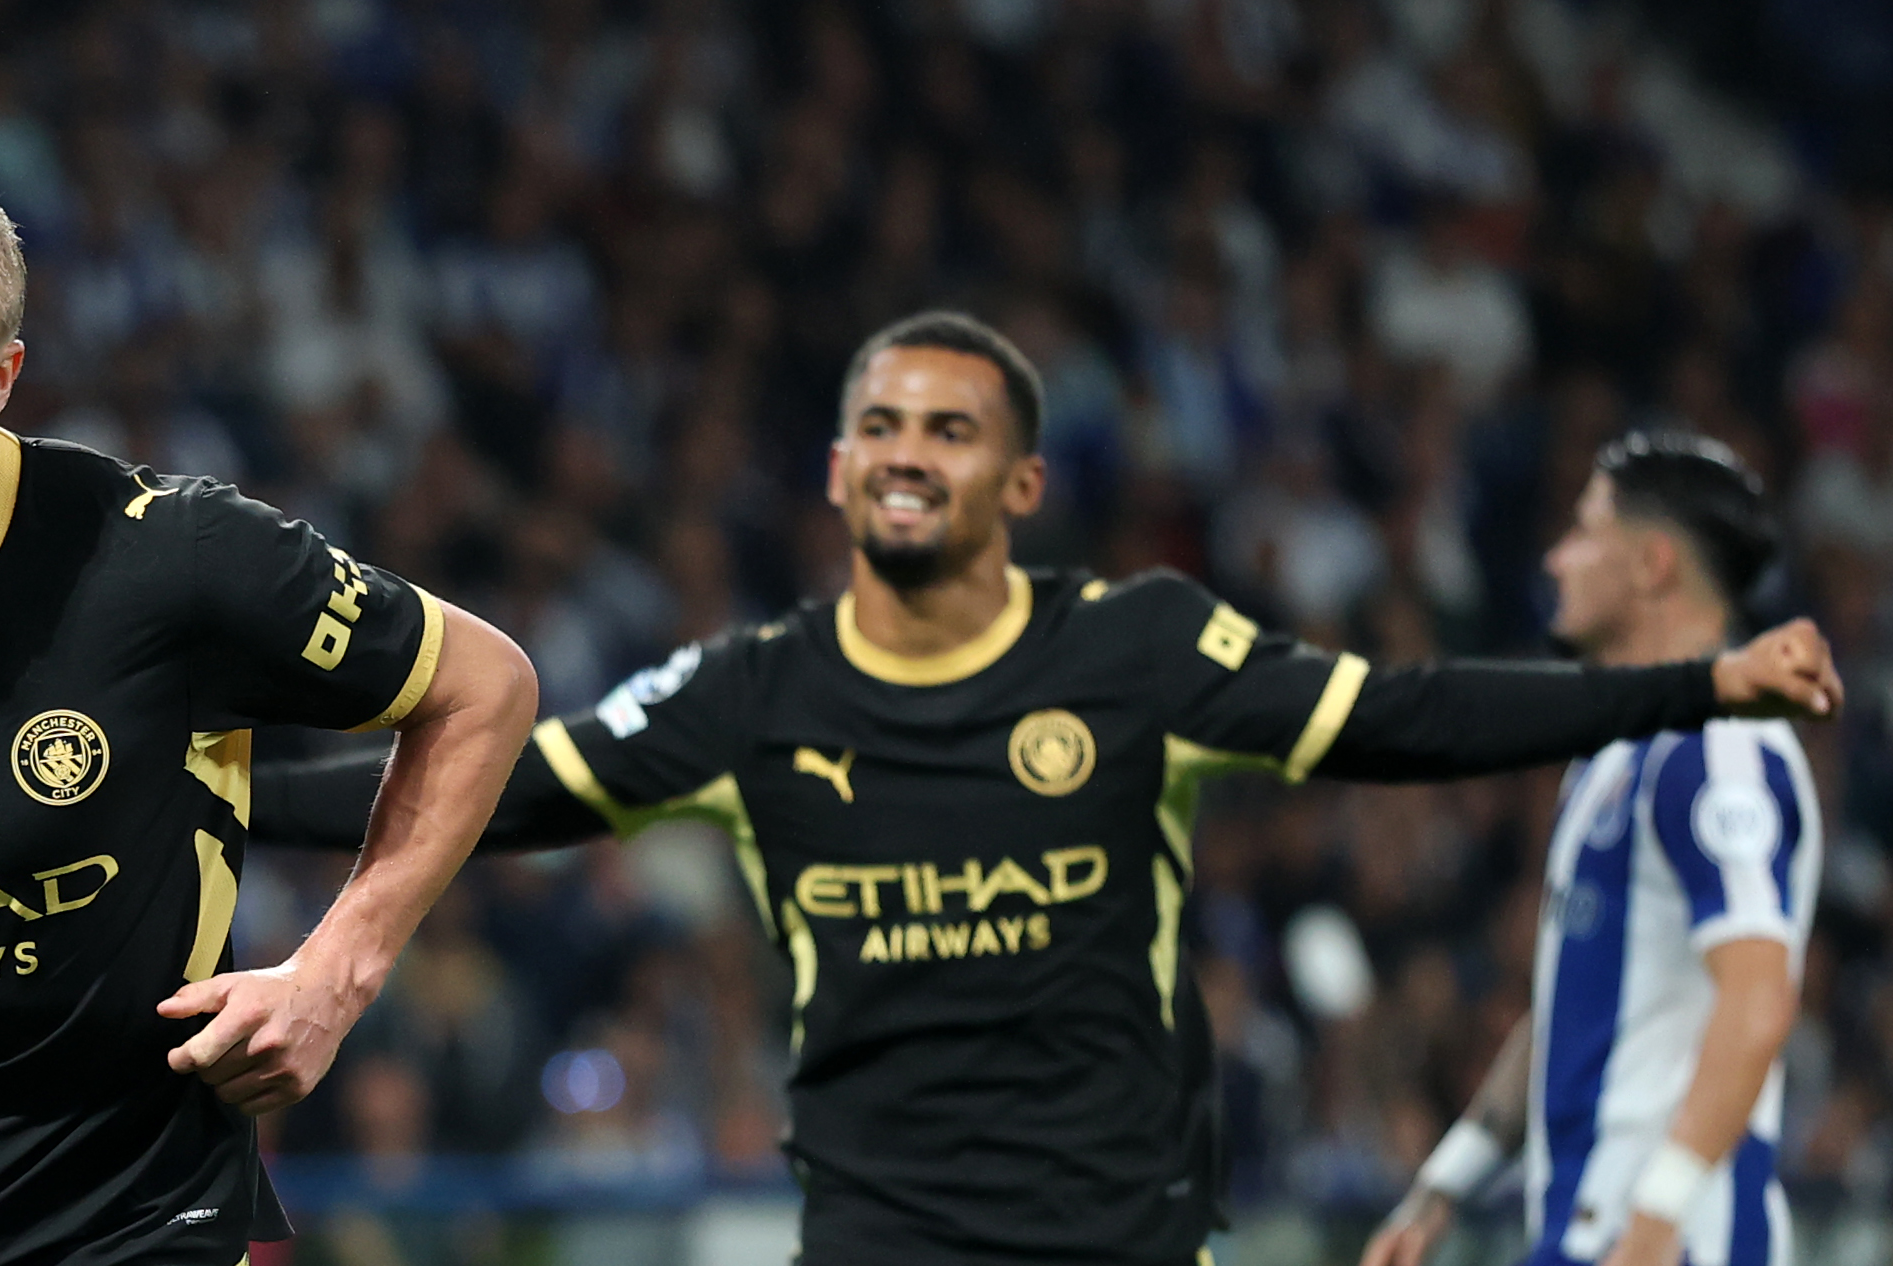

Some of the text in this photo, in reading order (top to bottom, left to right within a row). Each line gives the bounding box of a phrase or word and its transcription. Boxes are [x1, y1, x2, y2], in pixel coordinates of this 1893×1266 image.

[20, 717, 96, 751] MANCHESTER
[52, 786, 80, 799] CITY
[795, 845, 1108, 918] ETIHAD
[859, 913, 1052, 963] AIRWAYS
